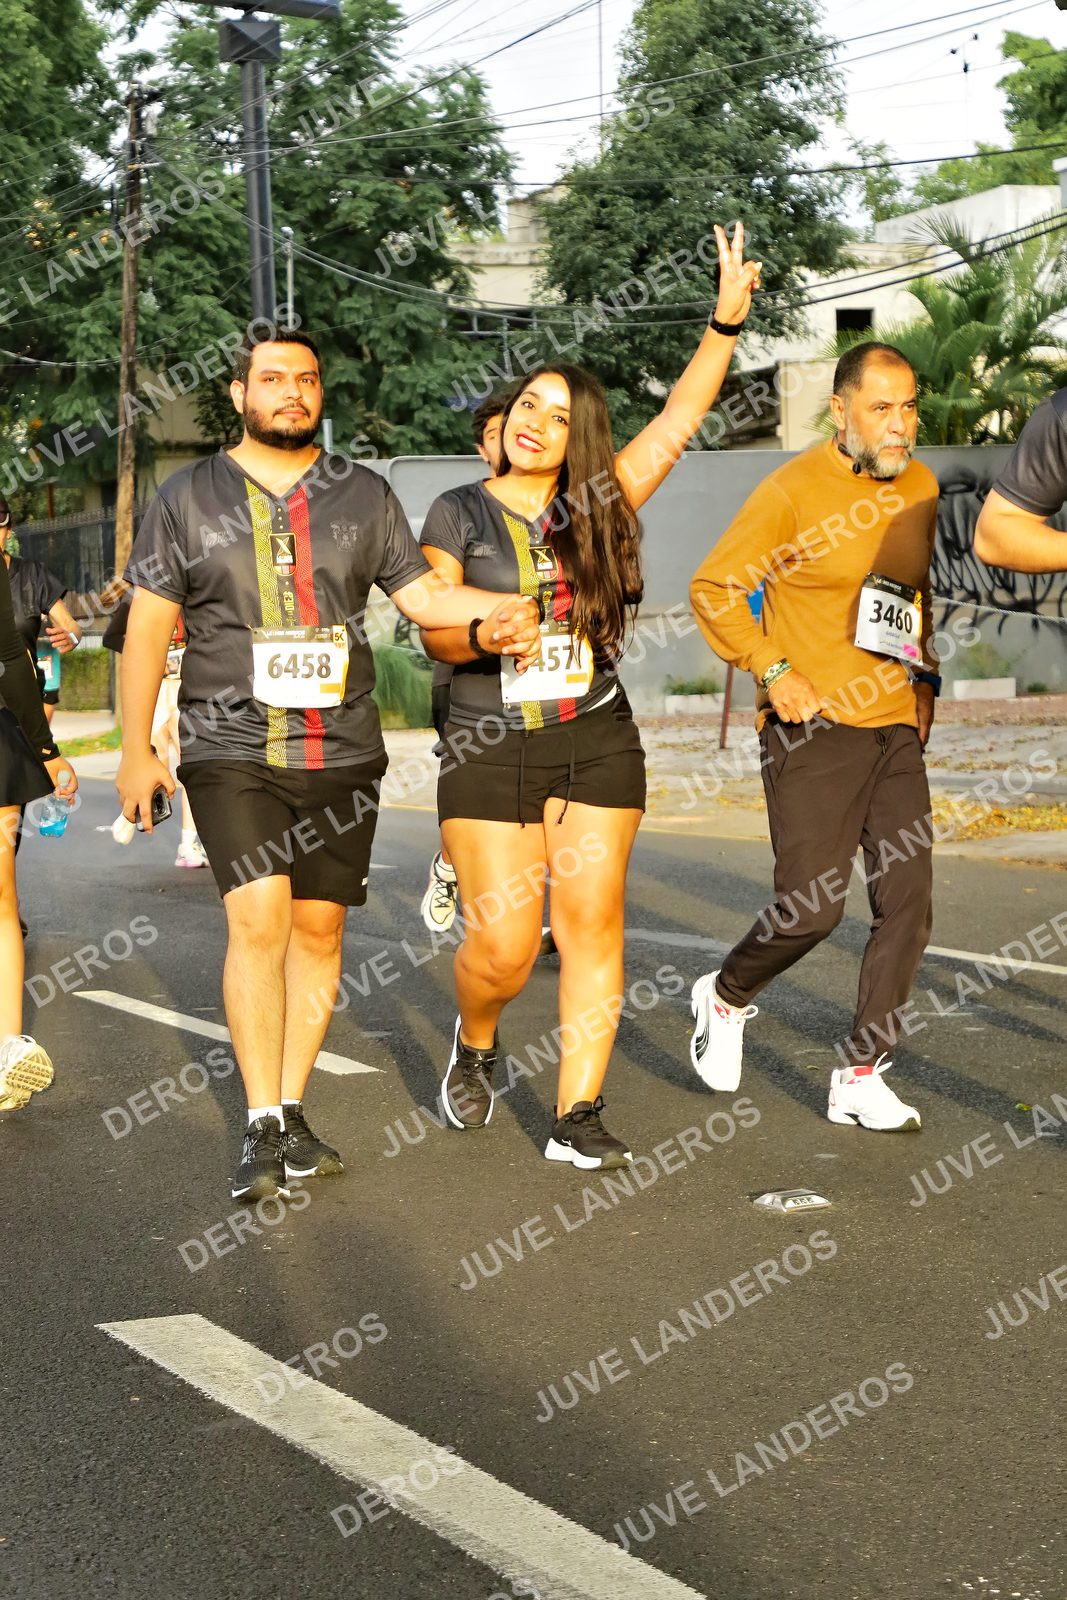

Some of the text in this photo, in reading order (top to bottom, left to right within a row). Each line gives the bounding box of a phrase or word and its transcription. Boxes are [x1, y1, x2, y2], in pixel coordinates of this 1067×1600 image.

[869, 599, 913, 634] 3460
[267, 652, 332, 679] 6458
[531, 645, 574, 672] 457
